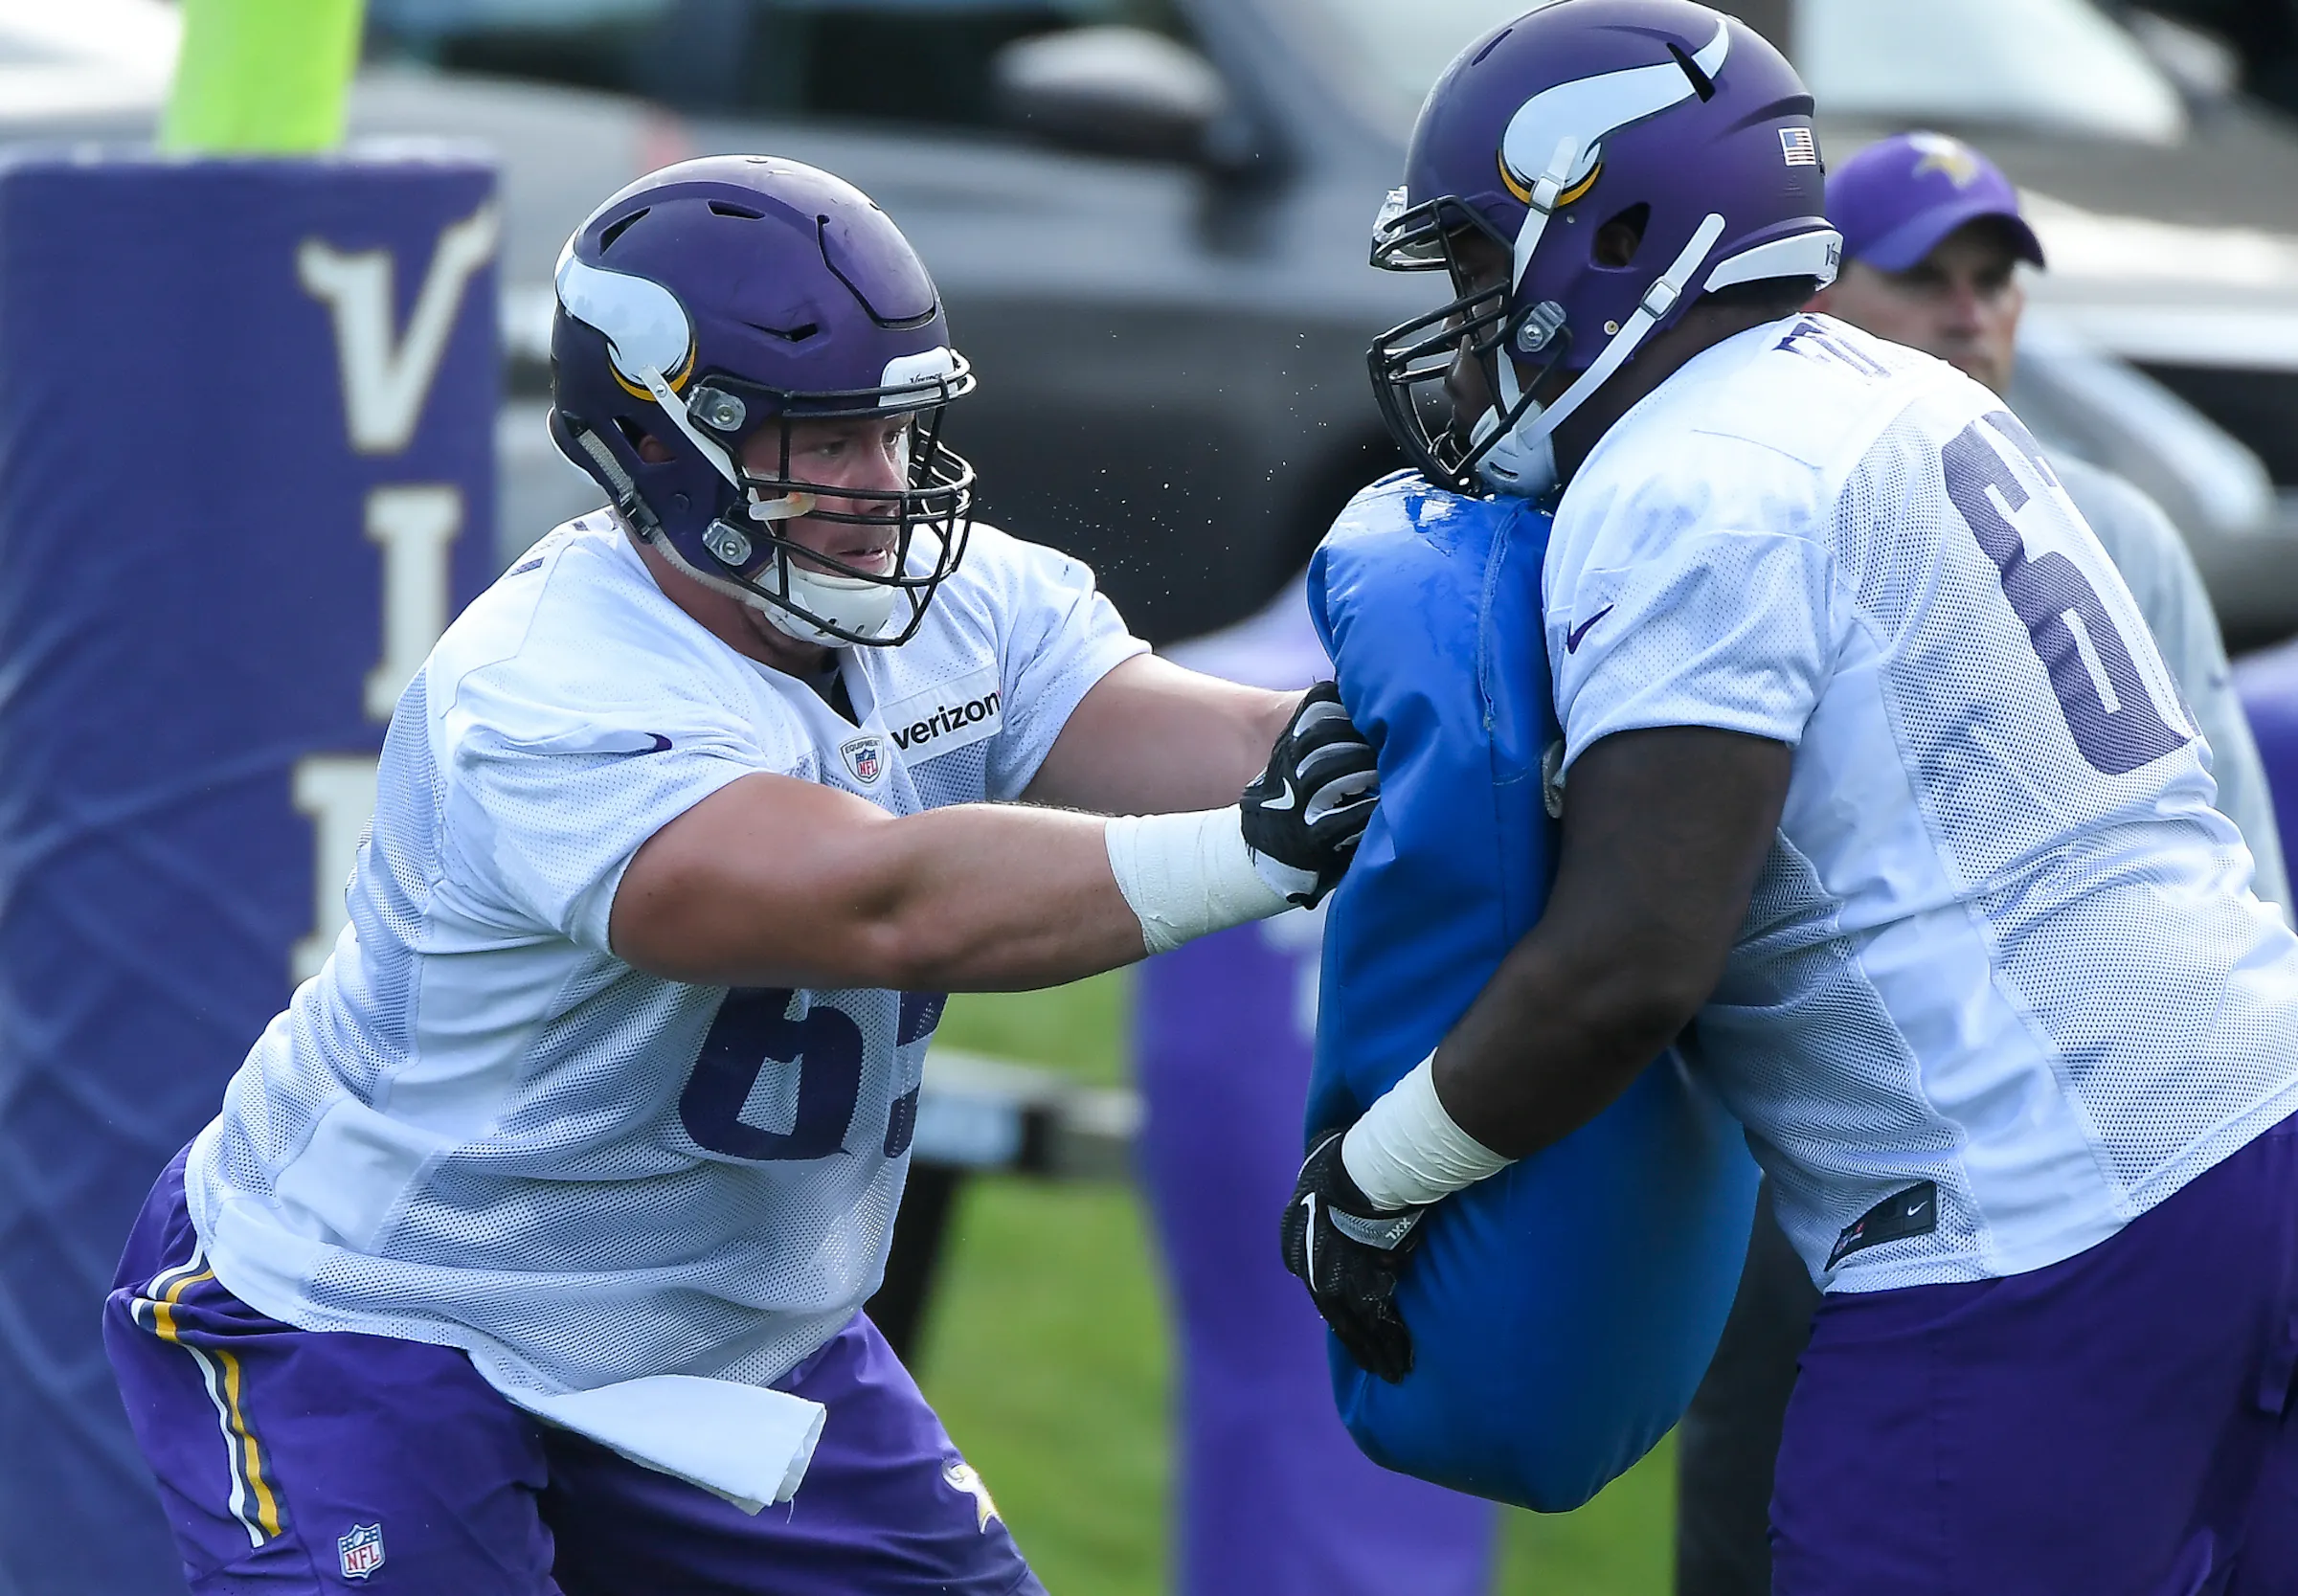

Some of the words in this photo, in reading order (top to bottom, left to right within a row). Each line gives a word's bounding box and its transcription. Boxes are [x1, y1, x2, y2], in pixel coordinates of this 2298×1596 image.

[891, 691, 1001, 751] verizon
[859, 760, 878, 776] NFL
[1385, 1217, 1411, 1240] XXL
[346, 1544, 379, 1571] NFL
